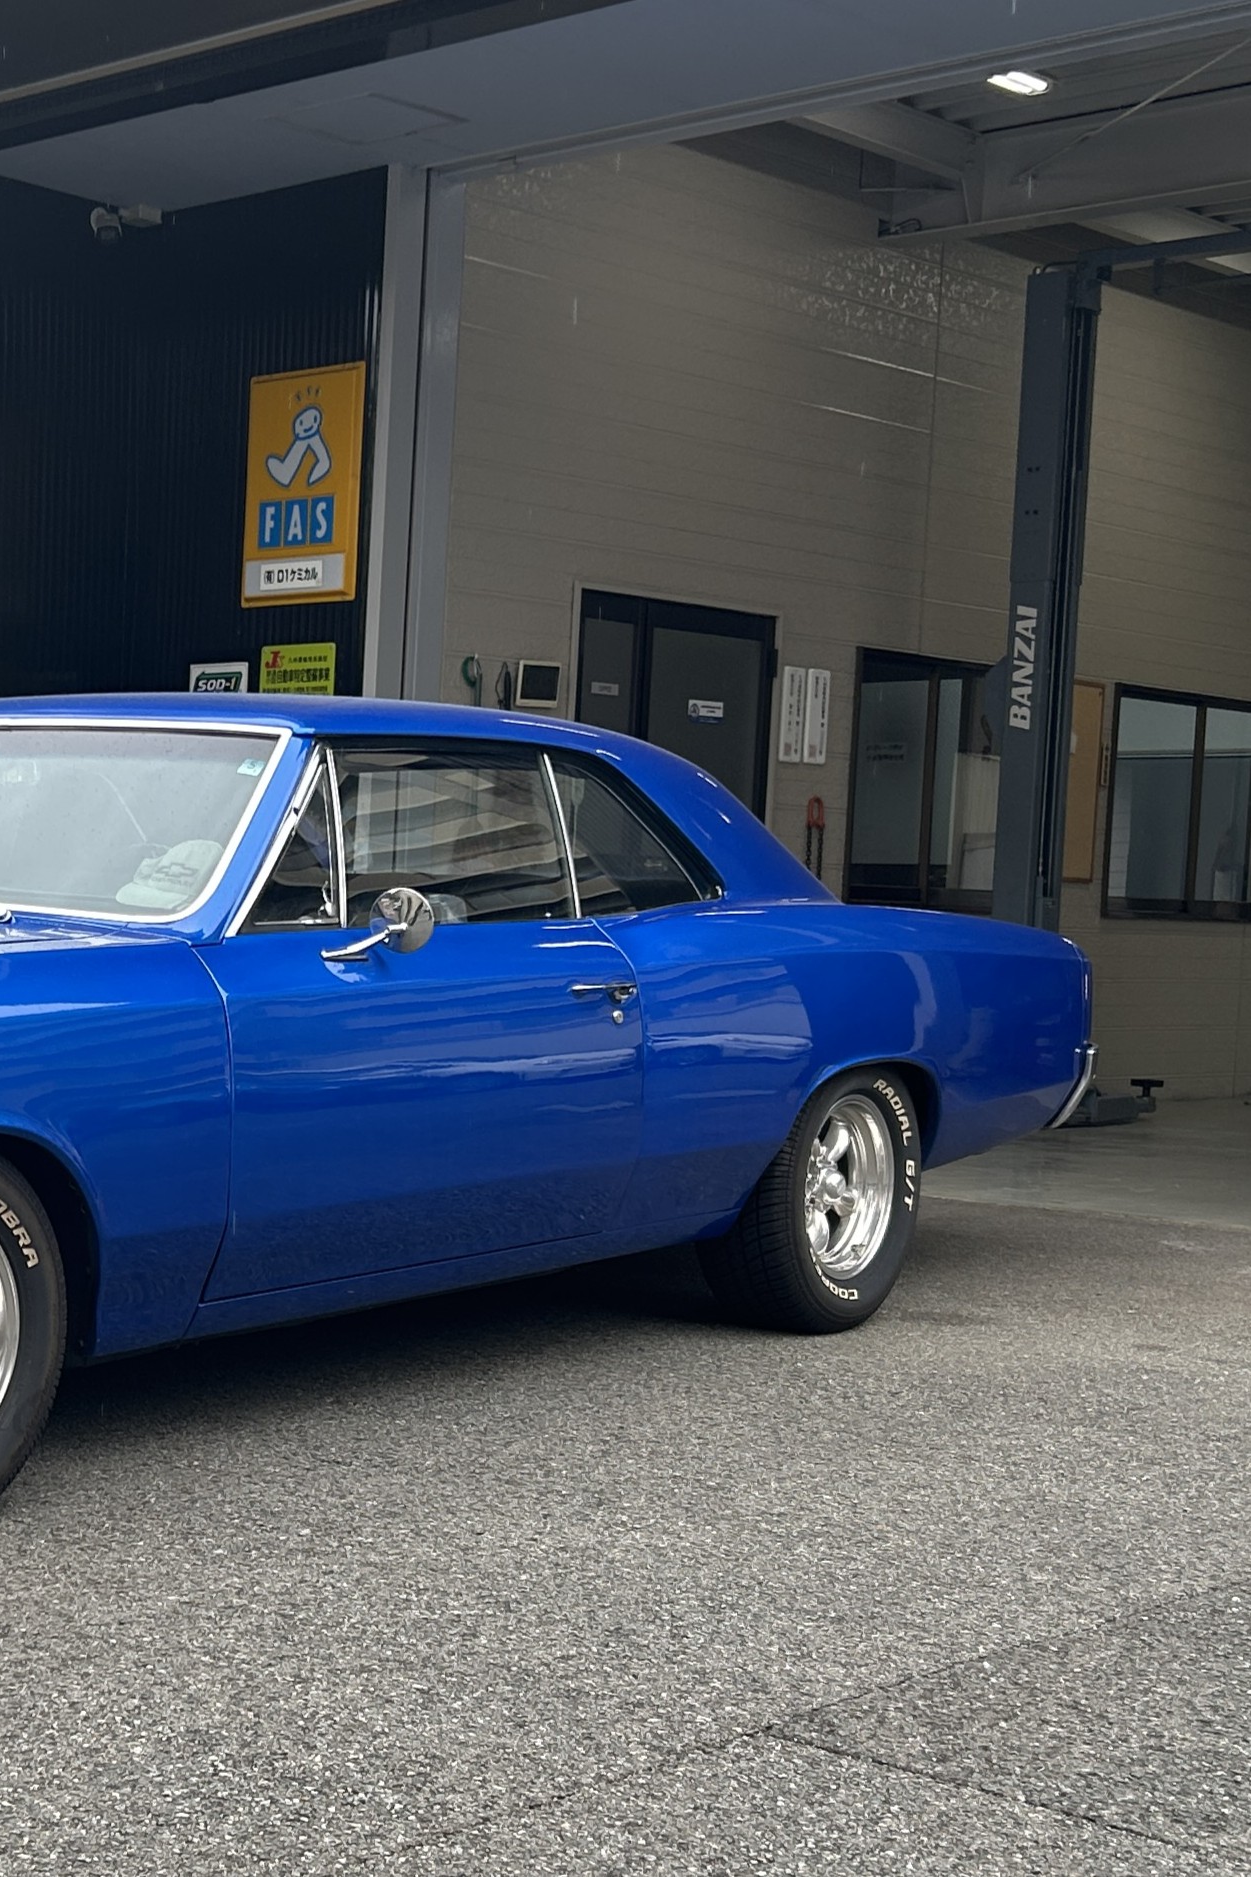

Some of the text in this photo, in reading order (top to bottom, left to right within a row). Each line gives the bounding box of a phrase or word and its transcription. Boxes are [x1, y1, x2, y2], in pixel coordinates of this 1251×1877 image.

[265, 502, 327, 543] FAS
[196, 677, 237, 692] SOD-1
[1008, 604, 1038, 730] BANZAI
[873, 1078, 916, 1212] RADIAL G/T
